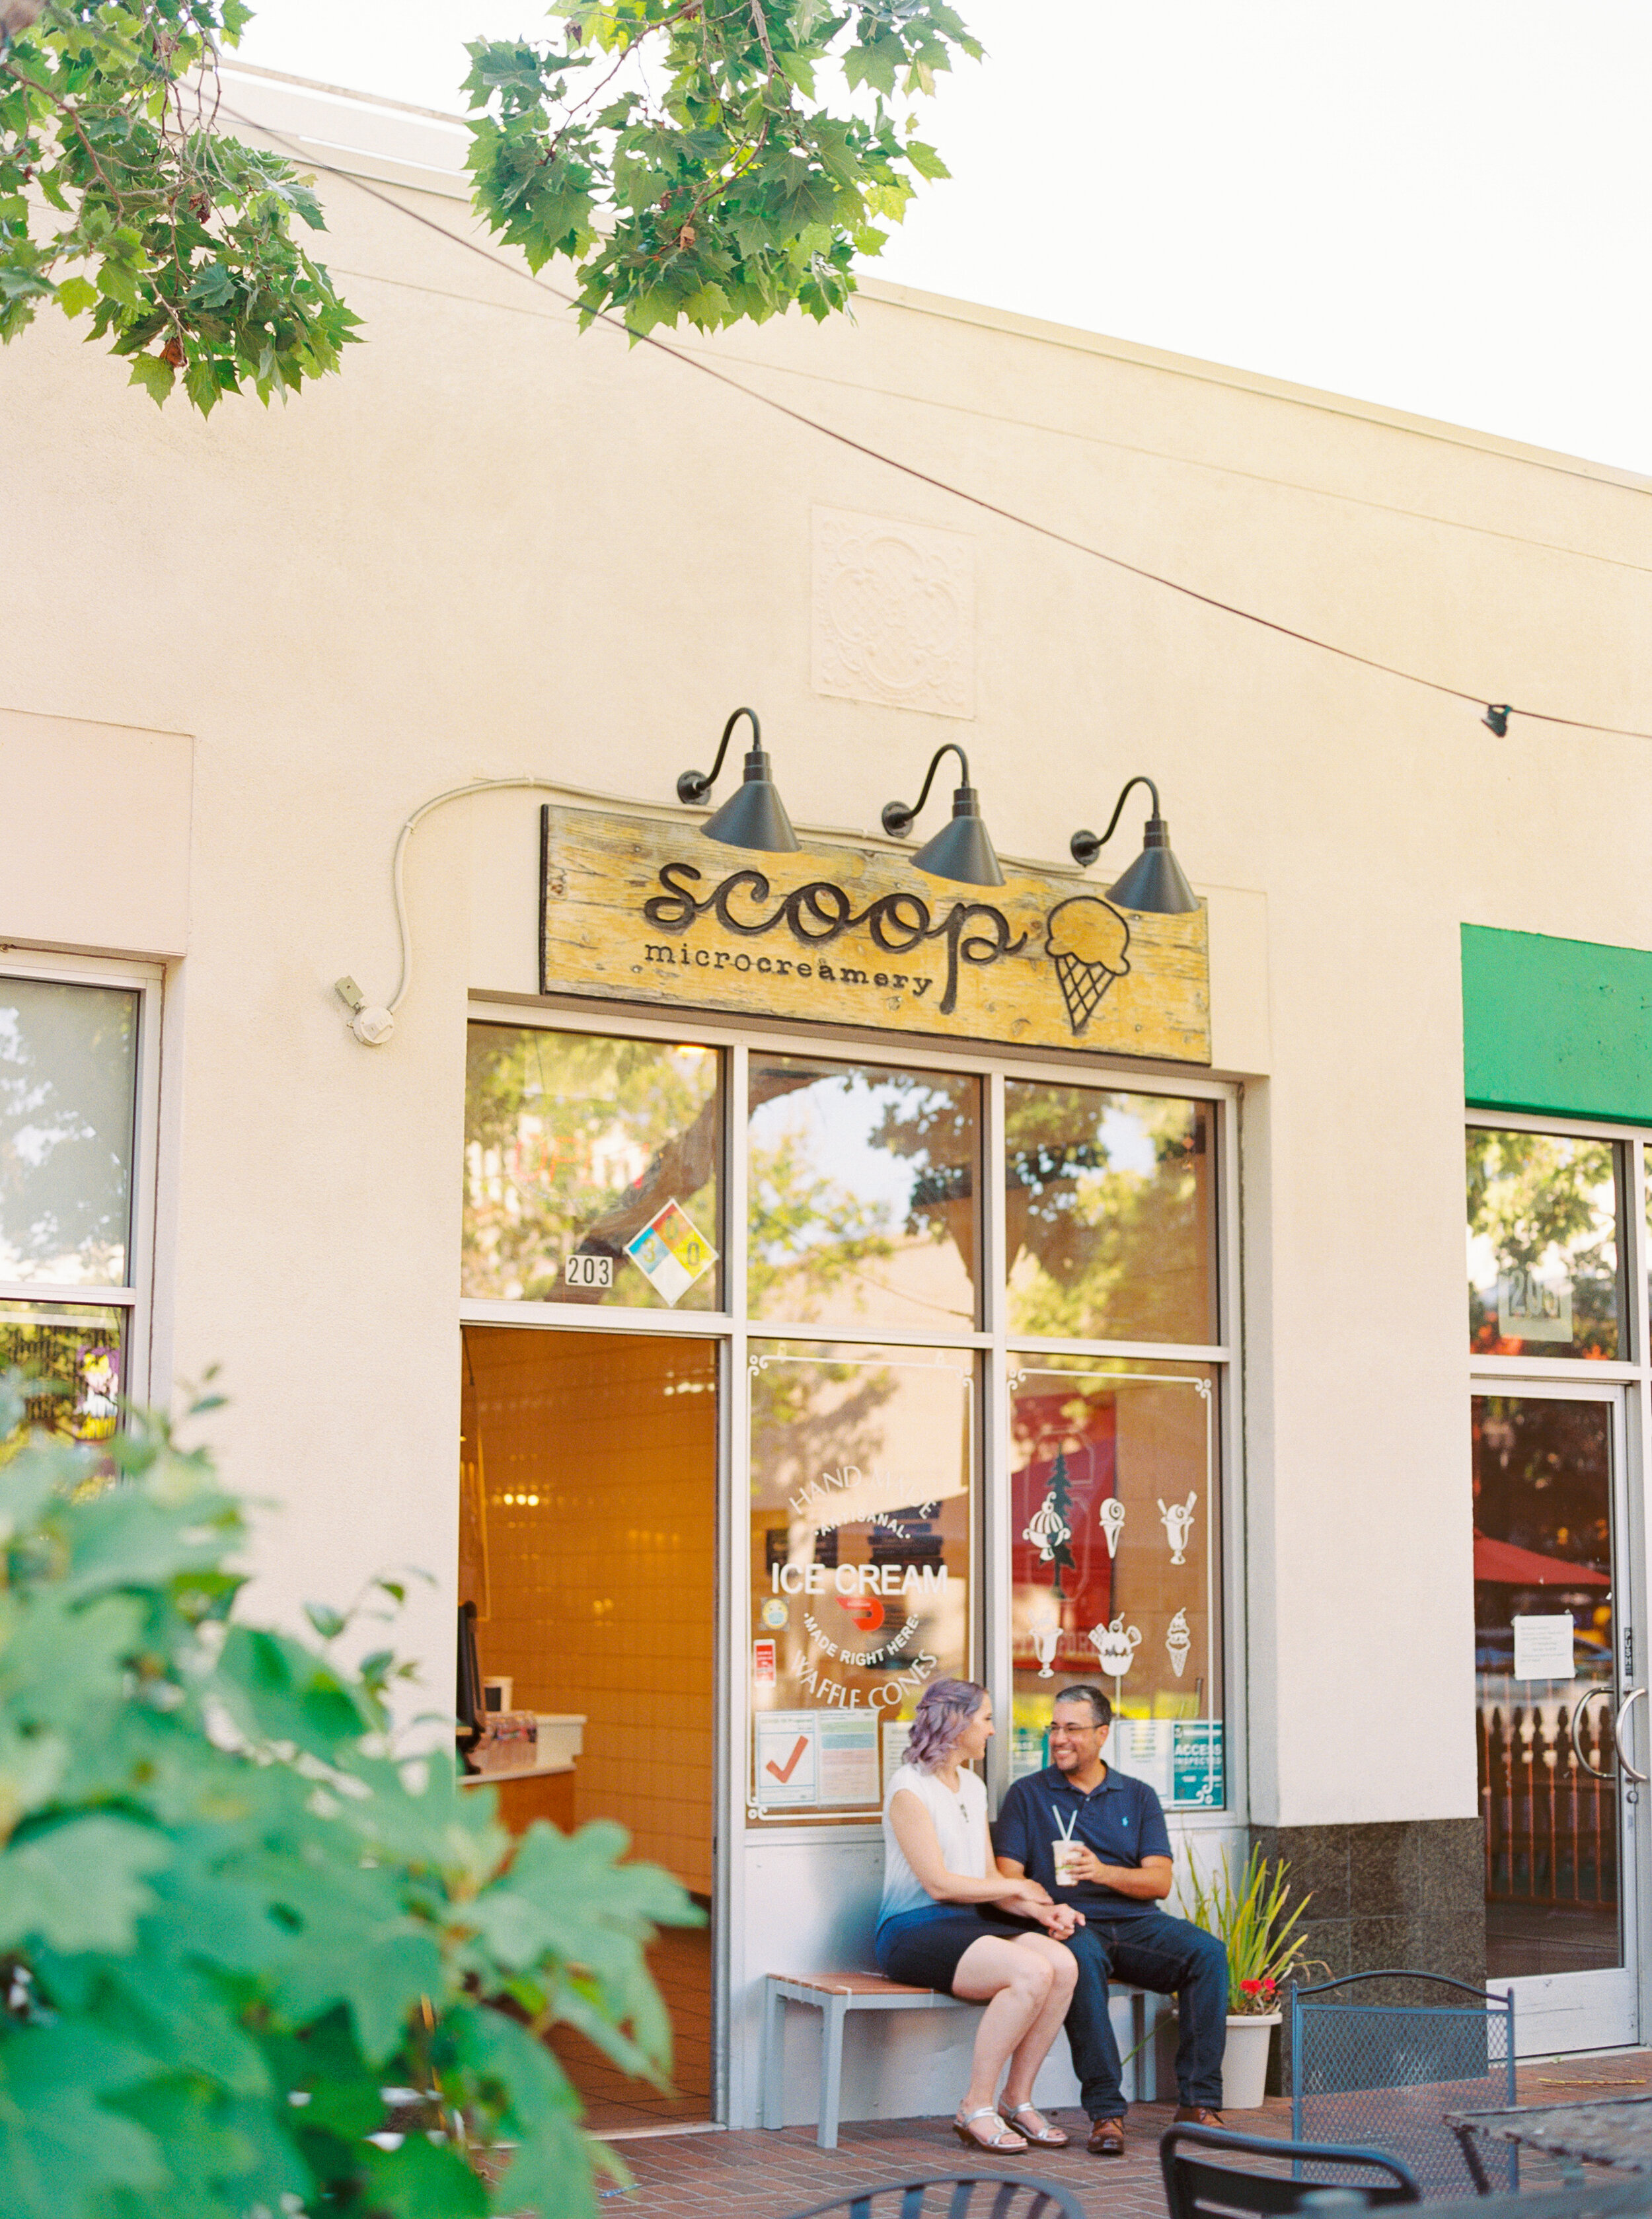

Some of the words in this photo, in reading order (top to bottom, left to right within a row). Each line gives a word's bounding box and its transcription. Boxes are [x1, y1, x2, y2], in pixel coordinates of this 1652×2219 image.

[644, 862, 1028, 1015] scoop
[644, 939, 934, 997] microcreamery
[568, 1257, 609, 1285] 203
[643, 1238, 657, 1263] 3
[687, 1240, 700, 1267] 0
[788, 1465, 862, 1516] HAND
[771, 1561, 826, 1595] ICE
[835, 1563, 948, 1596] CREAM
[804, 1615, 839, 1658] MADE
[839, 1647, 885, 1667] RIGHT
[885, 1616, 919, 1656] HERE
[793, 1649, 862, 1710] WAFFLE
[868, 1649, 938, 1710] CONES
